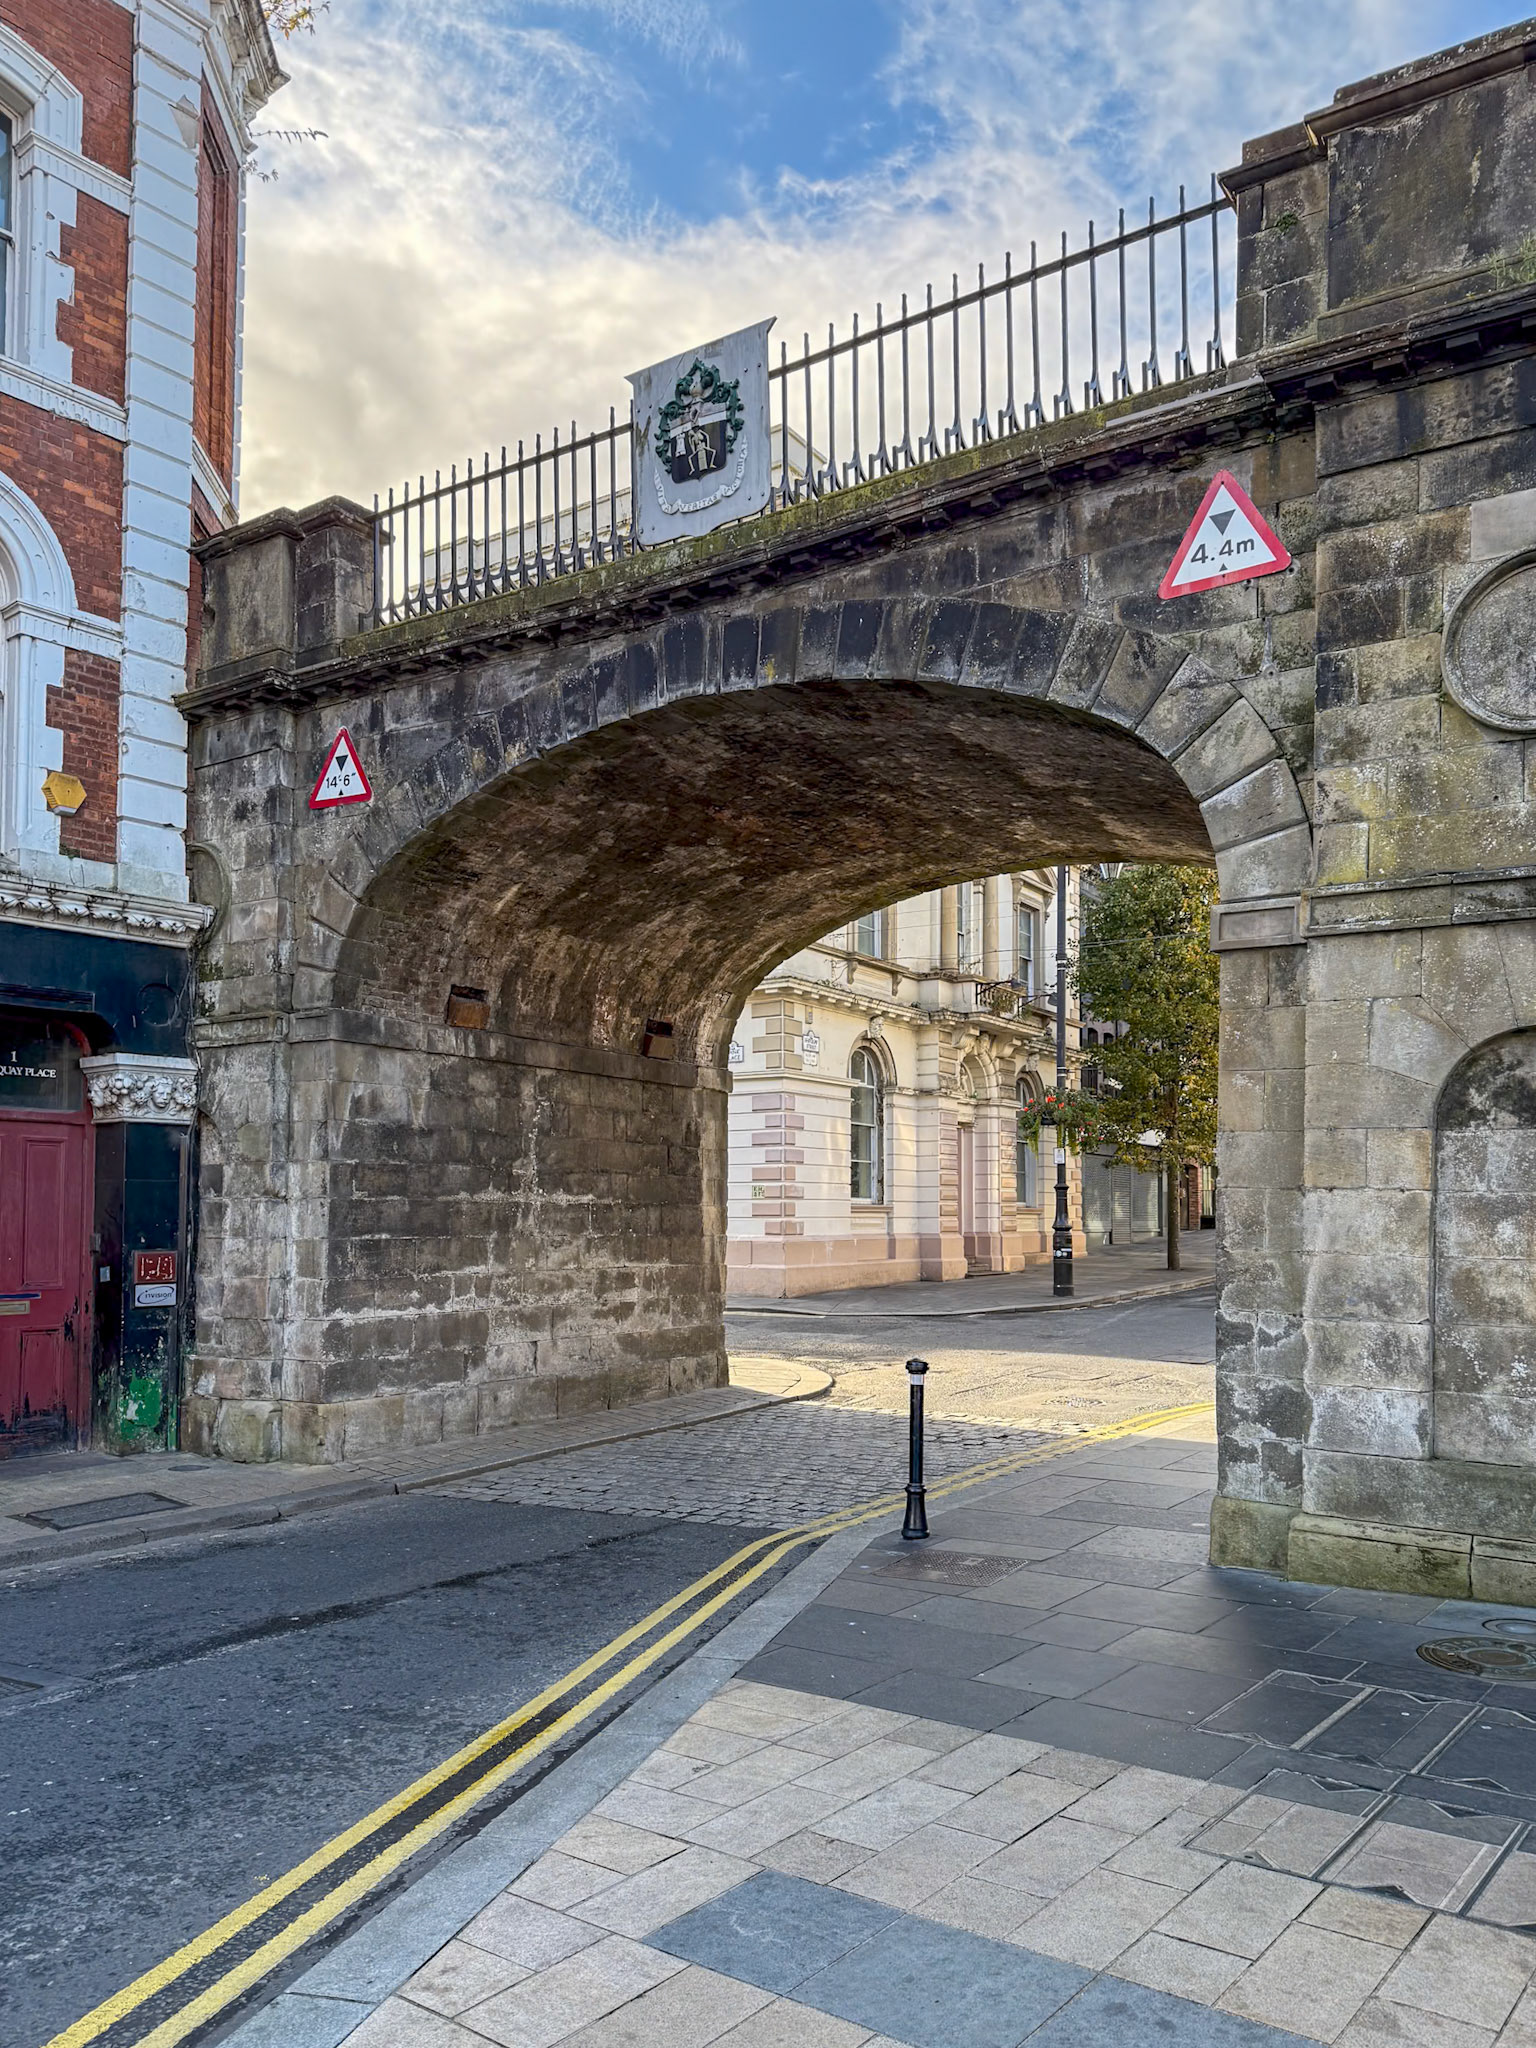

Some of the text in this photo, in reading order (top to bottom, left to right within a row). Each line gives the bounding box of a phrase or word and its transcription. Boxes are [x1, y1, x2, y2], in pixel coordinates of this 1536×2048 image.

[1190, 538, 1255, 564] 4.4m
[10, 1051, 18, 1062] 1
[25, 1067, 57, 1078] PLACE
